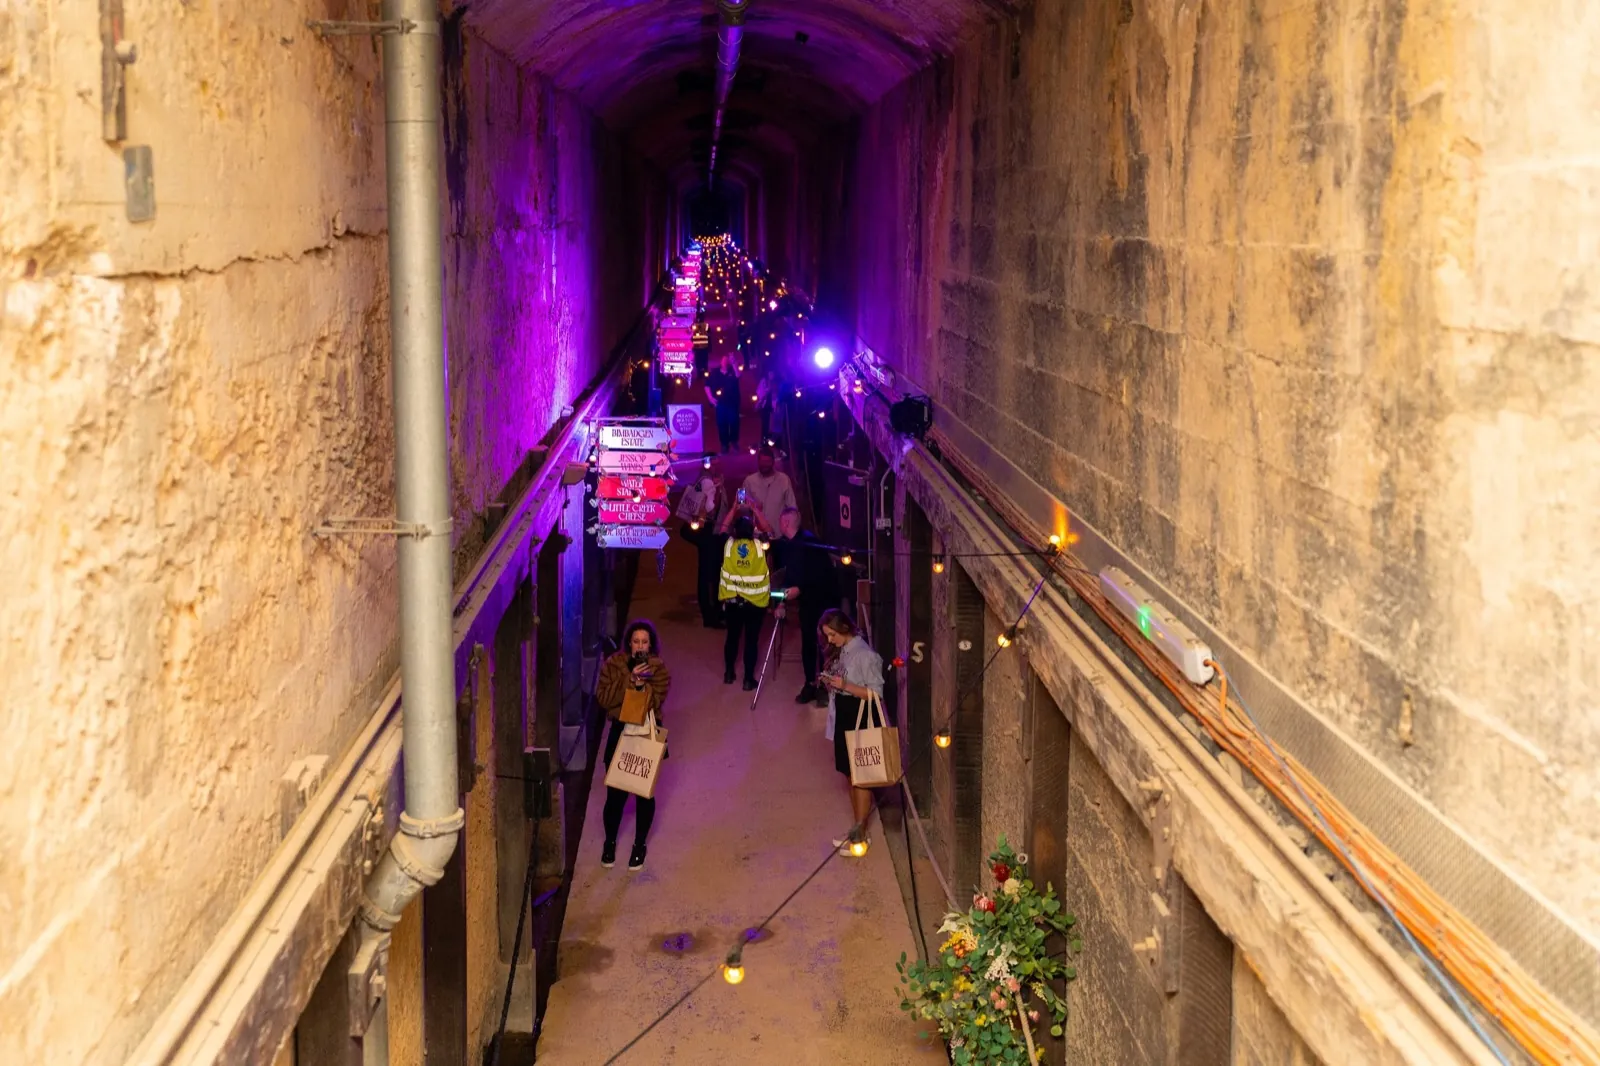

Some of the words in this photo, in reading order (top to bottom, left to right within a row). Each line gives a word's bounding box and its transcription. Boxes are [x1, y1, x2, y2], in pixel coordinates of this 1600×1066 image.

[611, 428, 654, 439] BIMBADGEN
[621, 438, 645, 447] ESTATE
[618, 454, 647, 463] JESSOP
[620, 462, 644, 471] WINES
[620, 478, 644, 488] WATER
[609, 503, 631, 513] LITTLE
[632, 503, 656, 514] CREEK
[618, 512, 647, 521] CHEESE
[911, 641, 926, 663] 5
[624, 752, 653, 769] HIDDEN
[617, 761, 649, 779] CELLAR
